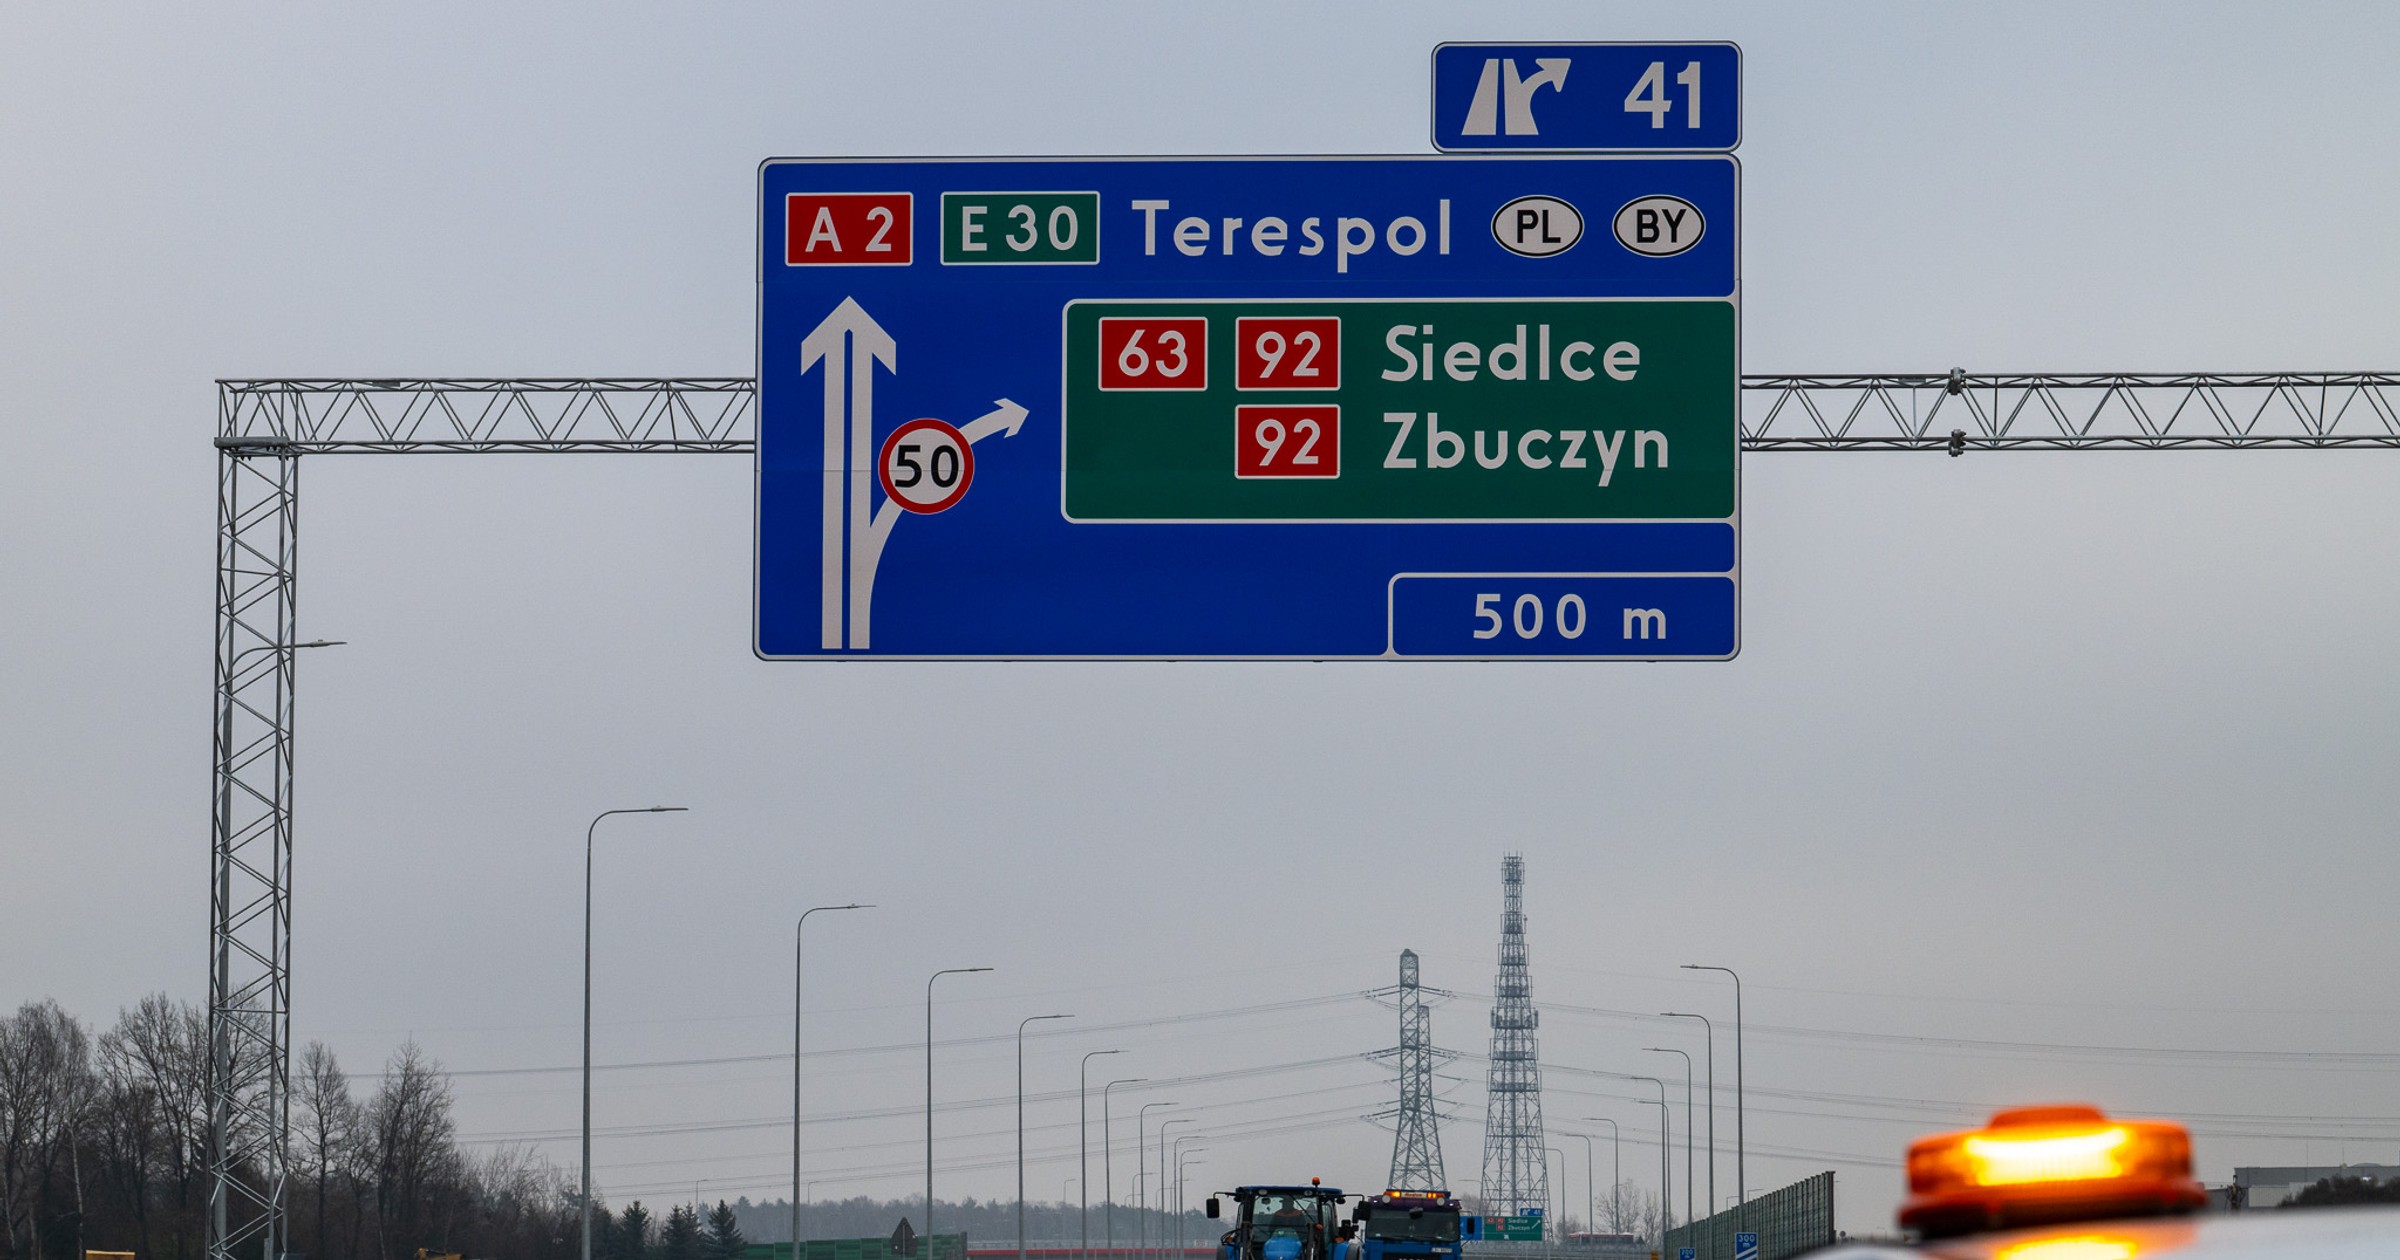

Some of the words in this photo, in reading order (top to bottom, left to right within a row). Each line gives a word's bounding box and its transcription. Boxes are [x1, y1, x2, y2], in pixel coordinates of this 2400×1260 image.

[1624, 61, 1702, 129] 41
[804, 206, 842, 252] A
[865, 206, 895, 252] 2
[961, 206, 988, 252] E
[1005, 205, 1079, 252] 30
[1131, 199, 1451, 273] Terespol
[1516, 210, 1561, 244] PL
[1636, 209, 1688, 244] BY
[1118, 330, 1188, 378] 63
[1255, 331, 1322, 378] 92
[1381, 324, 1641, 382] Siedlce
[1255, 419, 1322, 466] 92
[1383, 412, 1670, 487] Zbuczyn
[893, 444, 960, 489] 50
[1472, 593, 1588, 640] 500
[1622, 608, 1667, 640] m
[1738, 1234, 1755, 1243] 300
